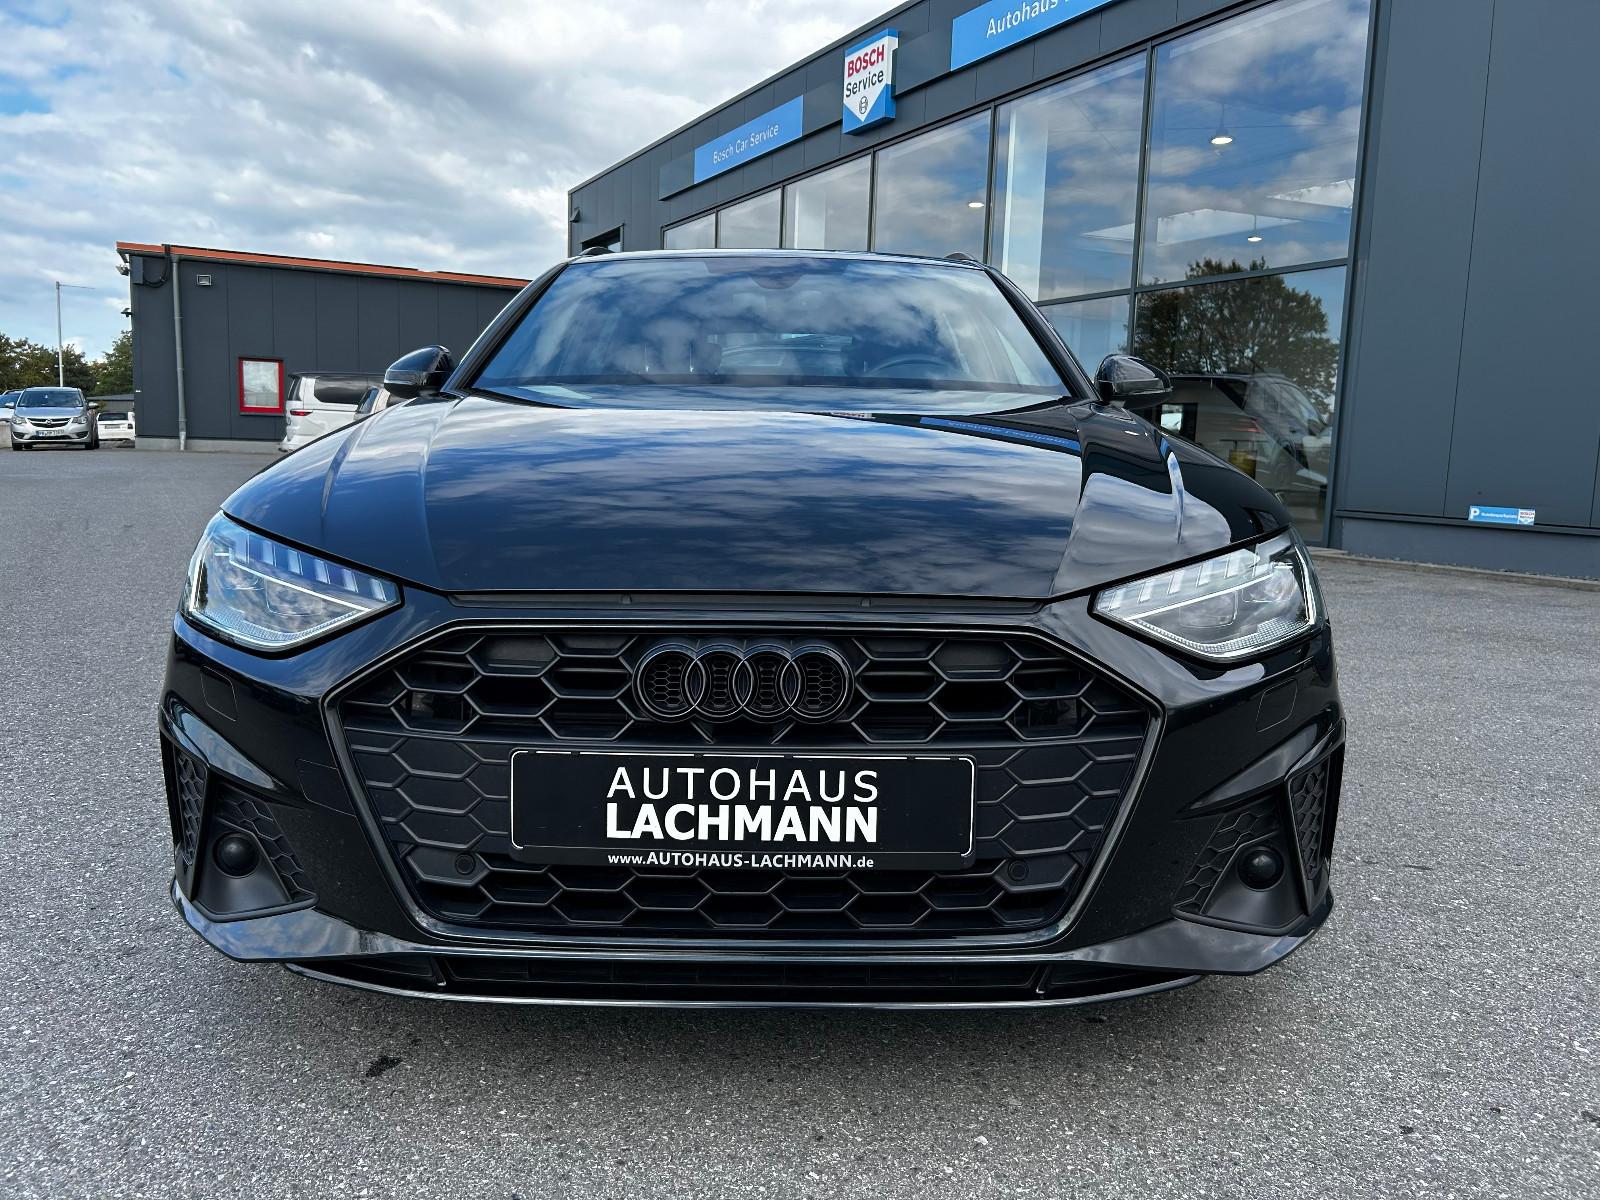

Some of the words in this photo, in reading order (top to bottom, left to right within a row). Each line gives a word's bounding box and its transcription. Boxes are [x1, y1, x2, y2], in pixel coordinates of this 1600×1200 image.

[986, 0, 1058, 38] Autohaus
[847, 44, 885, 78] BOSCH
[845, 70, 884, 98] Service
[713, 144, 734, 164] Bosch
[735, 139, 749, 153] Car
[750, 124, 779, 147] Service
[606, 767, 879, 803] AUTOHAUS
[606, 803, 879, 843] LACHMANN
[607, 851, 874, 868] www.AUTOHAUS-LACHMANN.de
